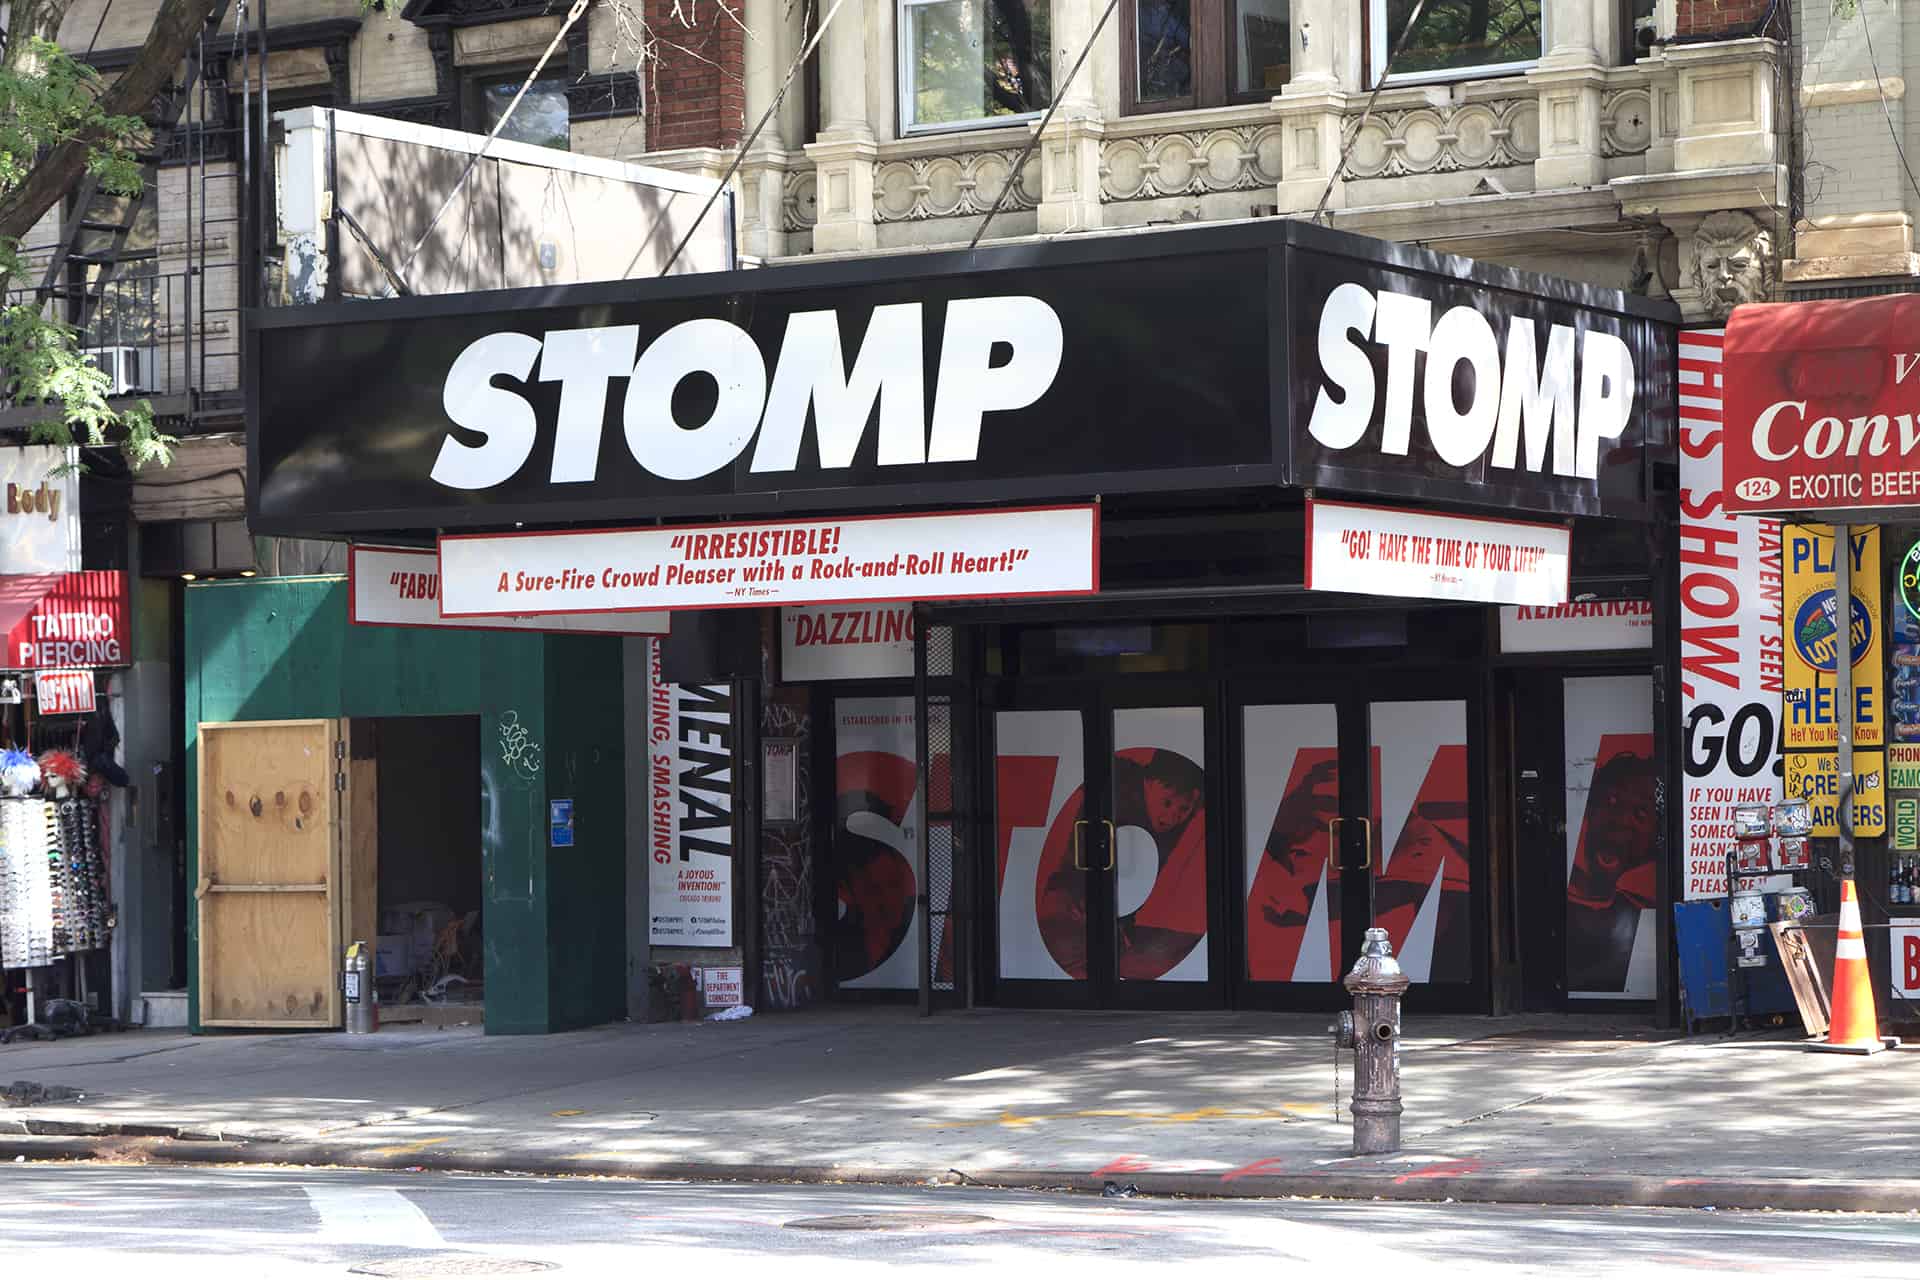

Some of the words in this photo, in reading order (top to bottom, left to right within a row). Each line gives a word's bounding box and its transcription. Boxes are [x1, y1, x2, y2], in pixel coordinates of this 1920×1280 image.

[430, 296, 1063, 490] STOMP
[1308, 283, 1634, 480] STOMP
[7, 481, 61, 522] Body
[1743, 481, 1772, 497] 124
[1789, 473, 1863, 500] EXOTIC
[670, 526, 841, 561] “IRRESISTIBLE!
[1341, 529, 1370, 559] “GO!
[1379, 533, 1408, 563] HAVE
[1411, 536, 1433, 565] THE
[1436, 537, 1462, 568] TIME
[1465, 541, 1479, 569] OF
[1483, 543, 1511, 572] YOUR
[389, 571, 439, 601] “FABU
[498, 571, 510, 593] A
[515, 568, 595, 592] Sure-Fire
[602, 564, 660, 588] Crowd
[666, 562, 737, 586] Pleaser
[743, 559, 785, 582] with
[791, 564, 803, 580] a
[810, 552, 945, 580] Rock-and-Roll
[951, 549, 1029, 574] Heart!”
[1758, 518, 1783, 628] HAVEN'T
[1821, 595, 1839, 615] NE
[32, 611, 114, 641] TATTOO
[19, 639, 121, 666] PIERCING
[1804, 618, 1867, 665] LOTRY
[1760, 634, 1783, 693] SEEN
[1792, 686, 1873, 724] HEE
[1683, 702, 1784, 778] GO!
[1809, 727, 1825, 742] You
[1855, 725, 1879, 741] Know
[1817, 757, 1831, 771] We
[1890, 768, 1920, 787] FAM
[1689, 787, 1701, 803] IF
[1706, 787, 1734, 803] YOU
[1737, 787, 1772, 803] HAVE
[1803, 773, 1865, 797] CREM
[653, 754, 672, 866] SMASHING
[1690, 806, 1721, 821] SEEN
[1724, 806, 1737, 821] IT
[1812, 805, 1884, 827] ARERS
[1897, 800, 1916, 847] WORLD
[1689, 824, 1736, 839] SOMEO
[678, 869, 684, 879] A
[685, 869, 715, 880] JOYOUS
[1690, 860, 1726, 875] SHAR
